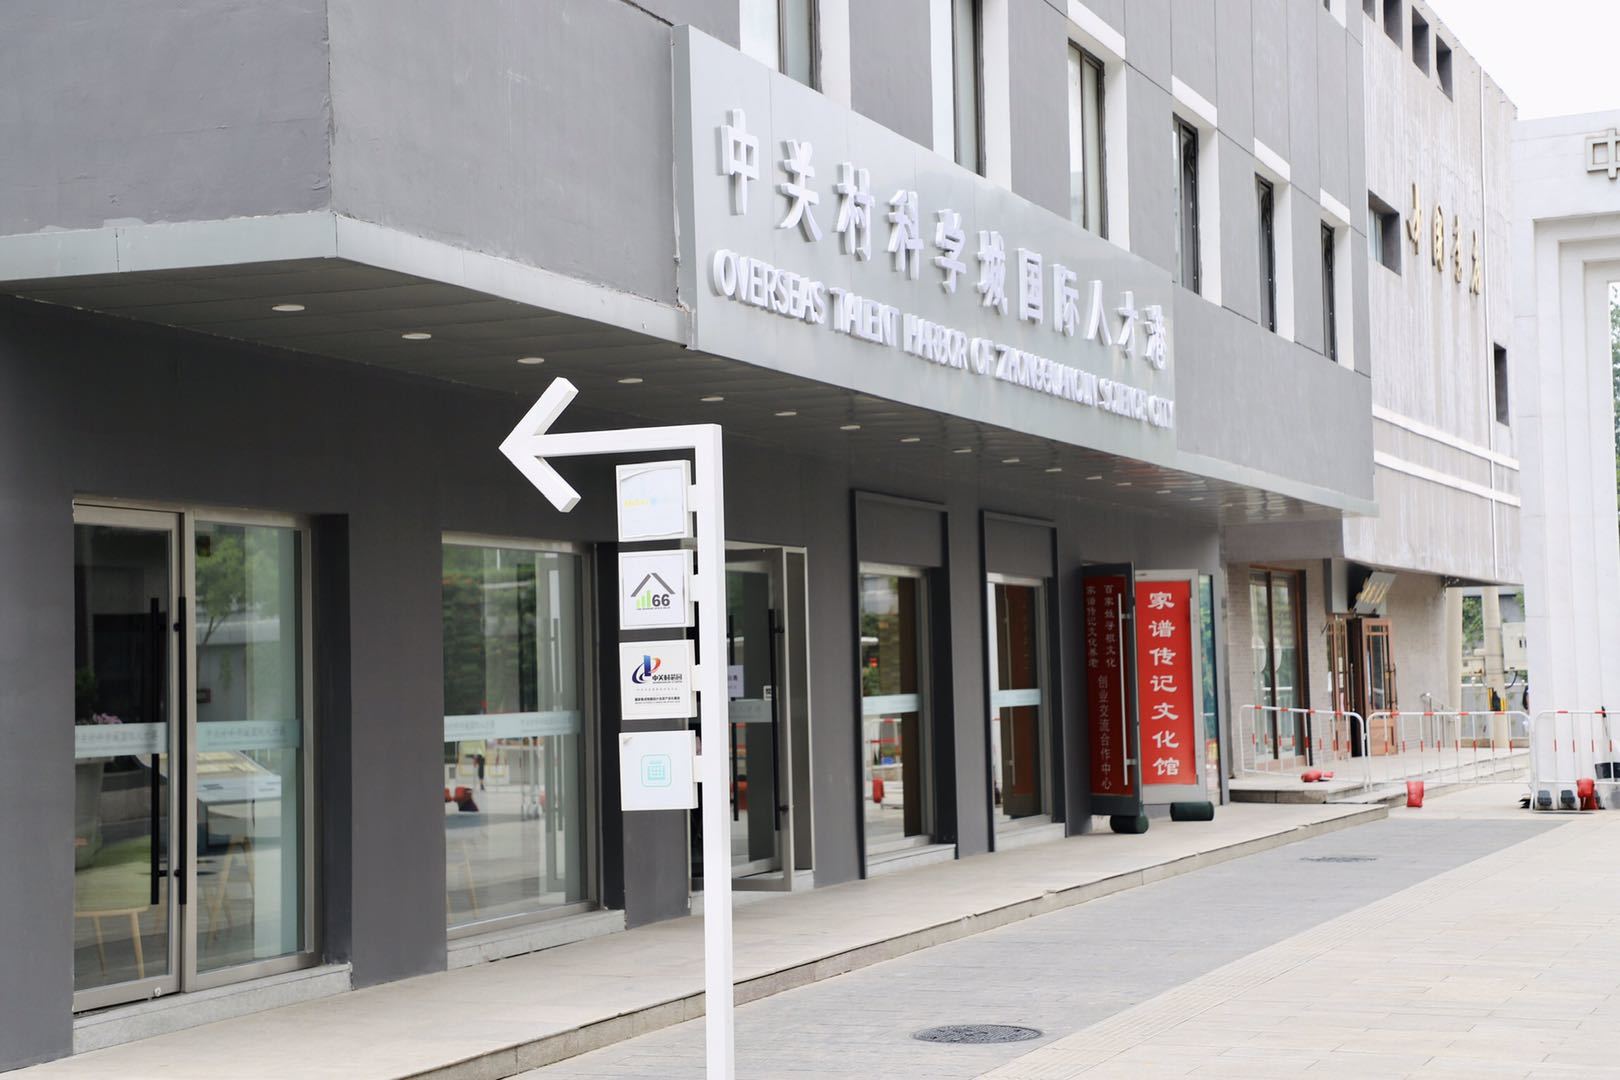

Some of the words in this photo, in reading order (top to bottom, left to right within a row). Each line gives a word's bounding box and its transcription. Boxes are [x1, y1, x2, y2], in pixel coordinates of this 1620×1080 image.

[1585, 128, 1620, 180] 中
[720, 108, 1167, 371] 中关村科学城国际人才港
[713, 248, 825, 325] OVERSEAS
[829, 286, 899, 347] TALENT
[903, 313, 967, 370] HARBOR
[970, 337, 993, 376] OF
[652, 594, 671, 607] 66
[1097, 674, 1112, 791] 创业交流合作中心
[1147, 591, 1180, 776] 家谱传记文化馆
